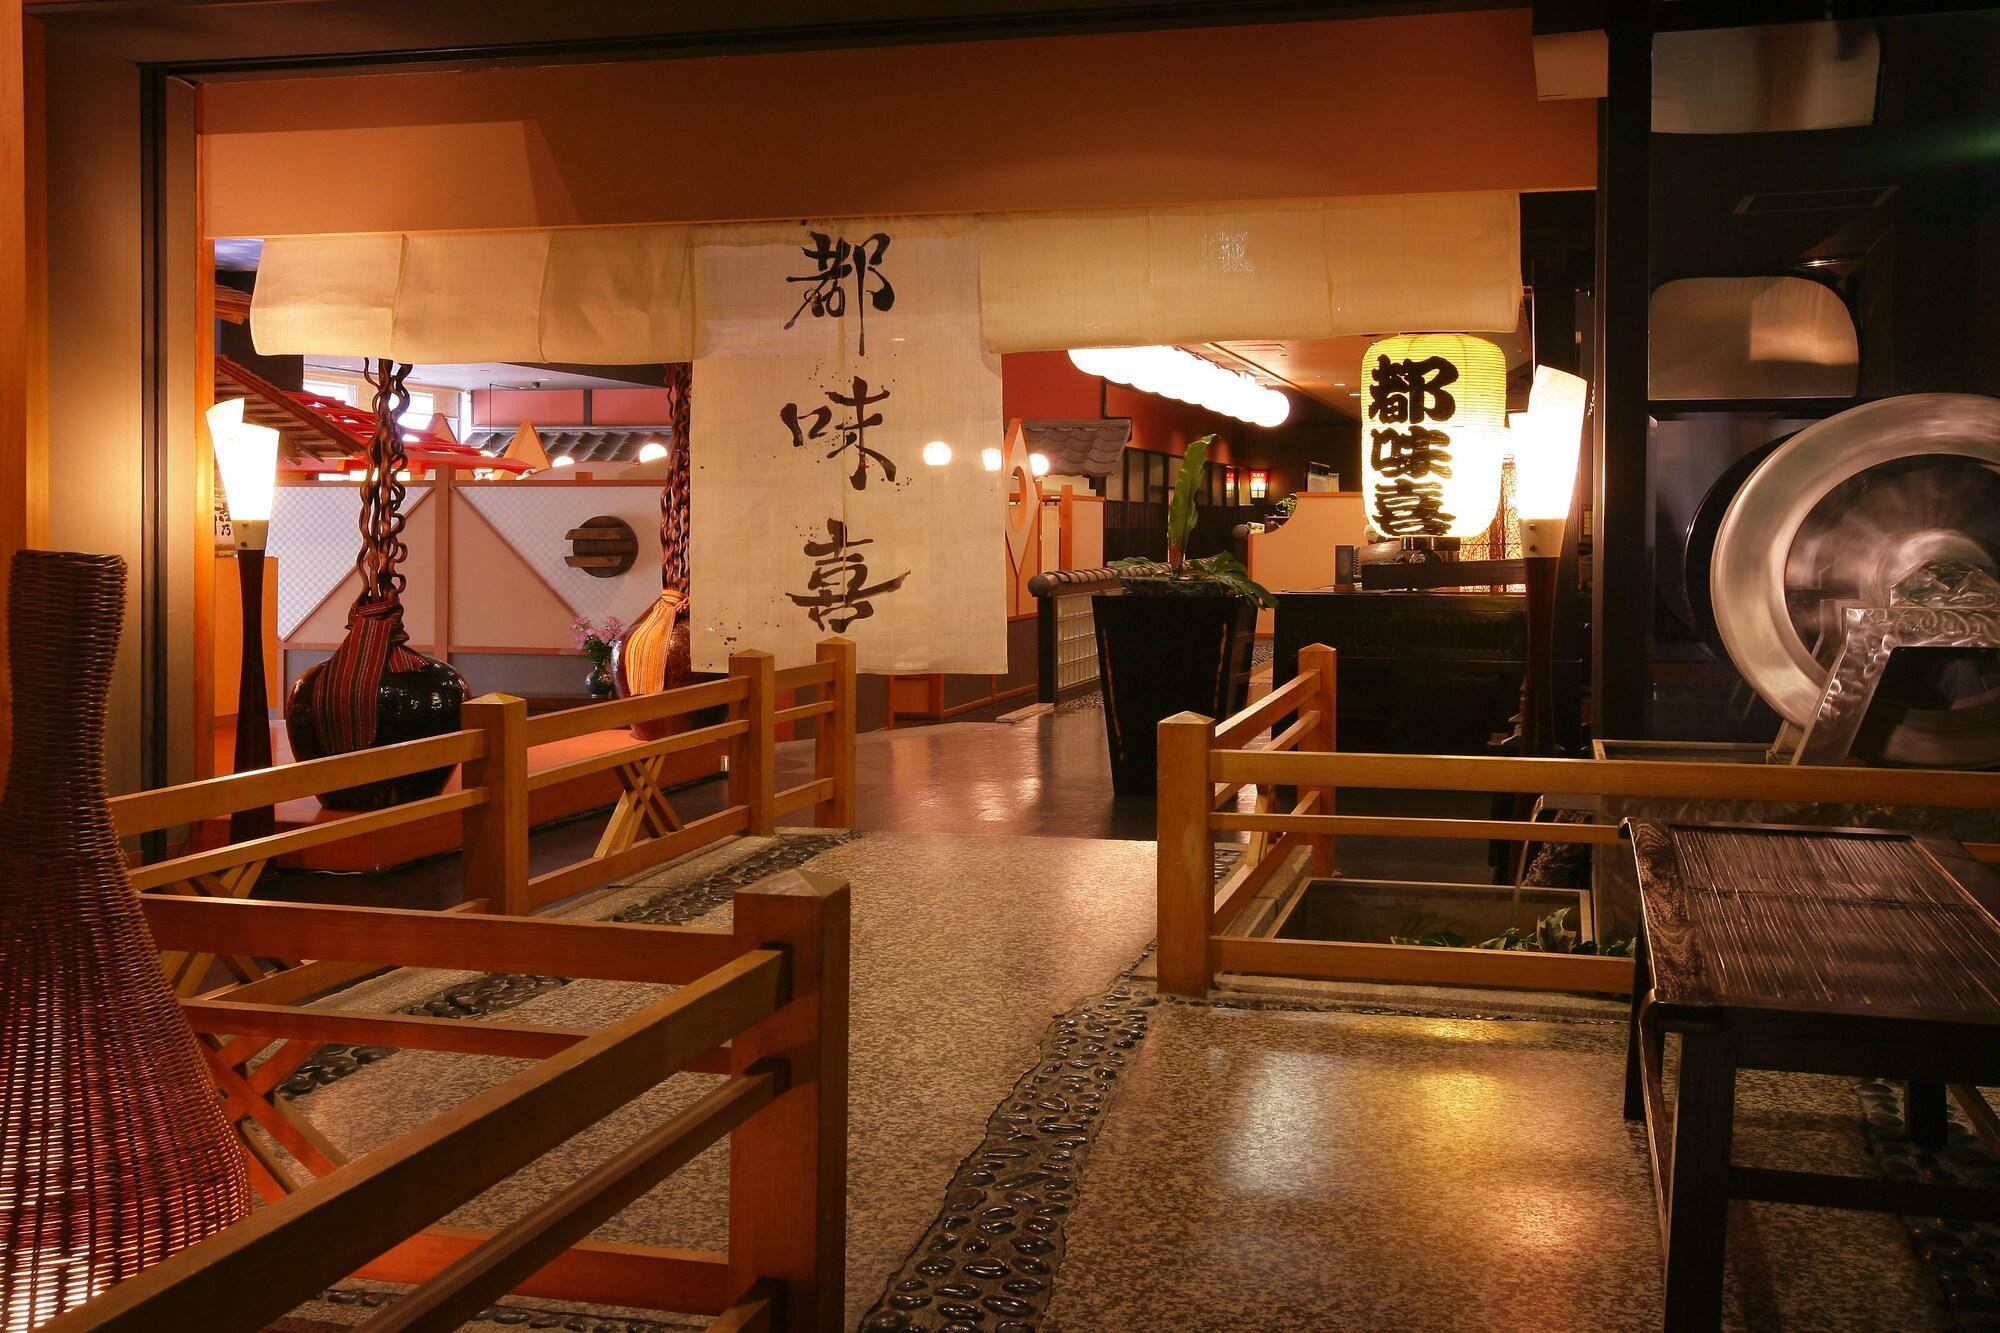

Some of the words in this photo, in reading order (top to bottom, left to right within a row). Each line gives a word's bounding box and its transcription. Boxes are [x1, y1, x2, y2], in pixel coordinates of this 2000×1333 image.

[780, 231, 911, 634] 都味喜
[1368, 354, 1459, 537] 都味喜
